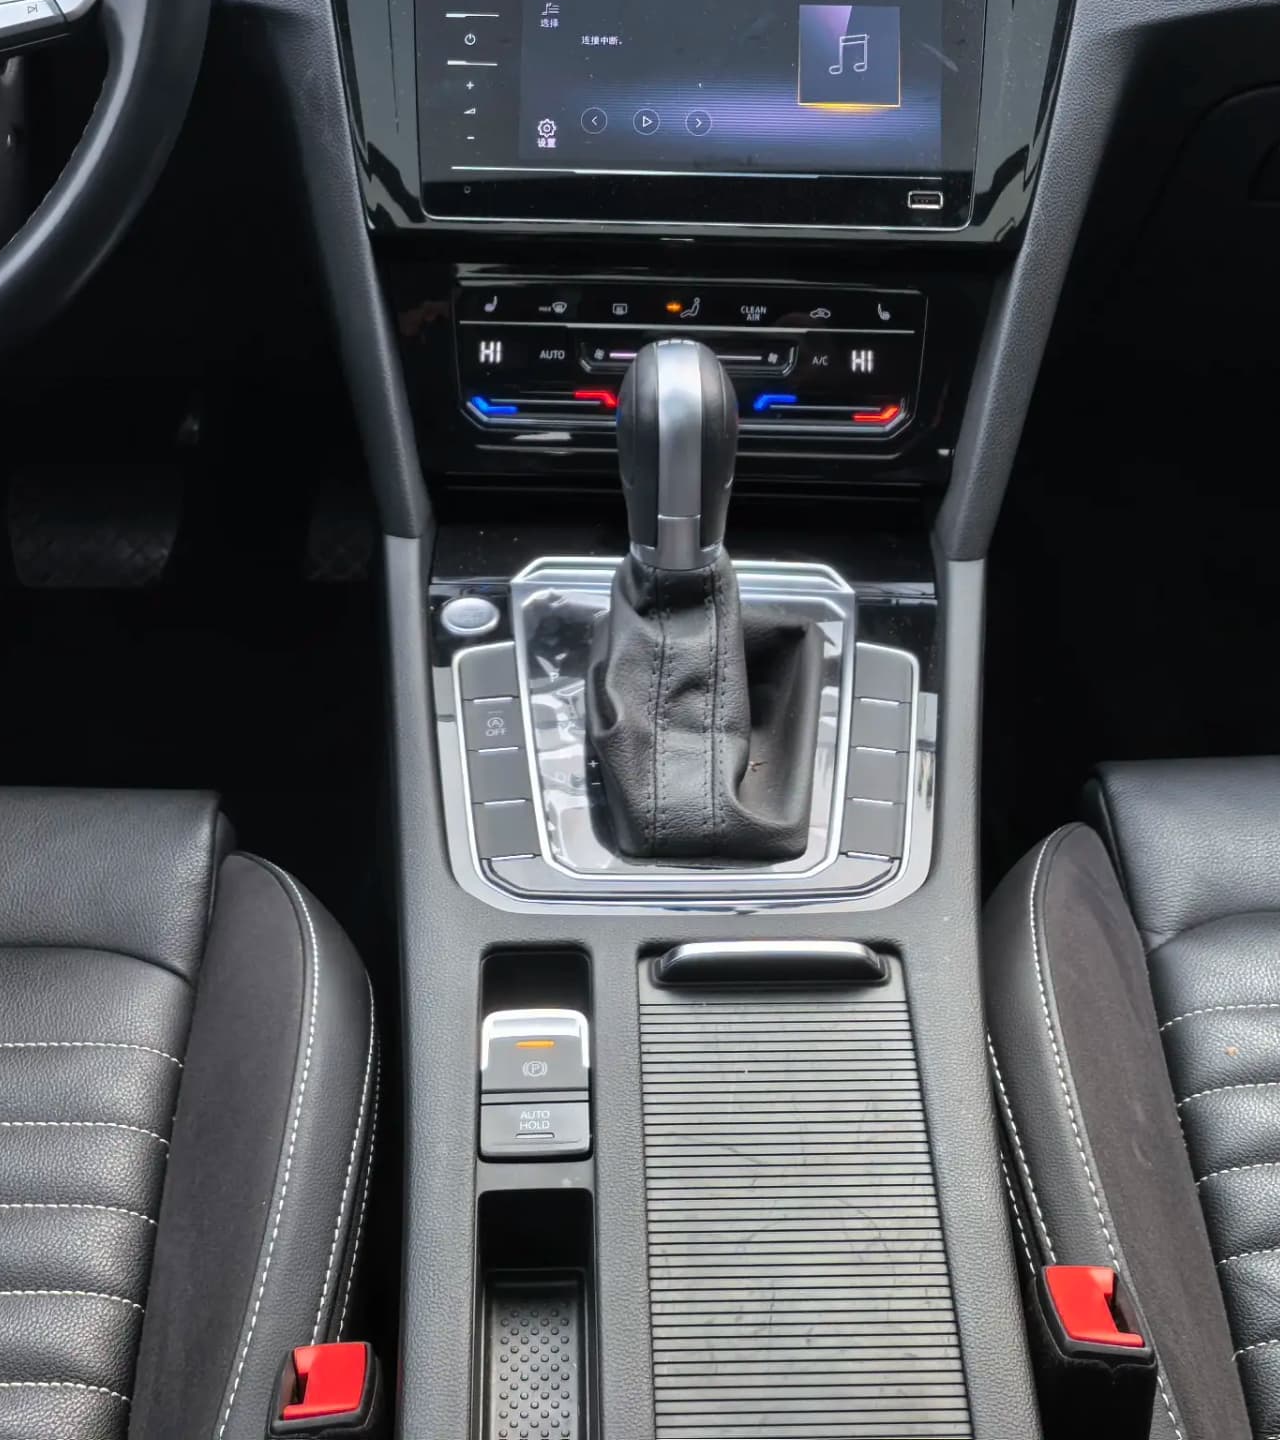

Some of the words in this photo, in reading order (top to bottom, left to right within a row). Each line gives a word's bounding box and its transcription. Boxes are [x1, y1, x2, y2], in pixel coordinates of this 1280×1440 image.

[740, 305, 767, 315] CLEAN
[746, 313, 760, 322] AIR
[479, 340, 502, 364] HI
[539, 349, 566, 360] AUTO
[812, 355, 829, 366] A/C
[850, 349, 875, 373] HI
[485, 727, 508, 737] OFF
[520, 1110, 551, 1120] AUTO
[519, 1120, 551, 1131] HOLD
